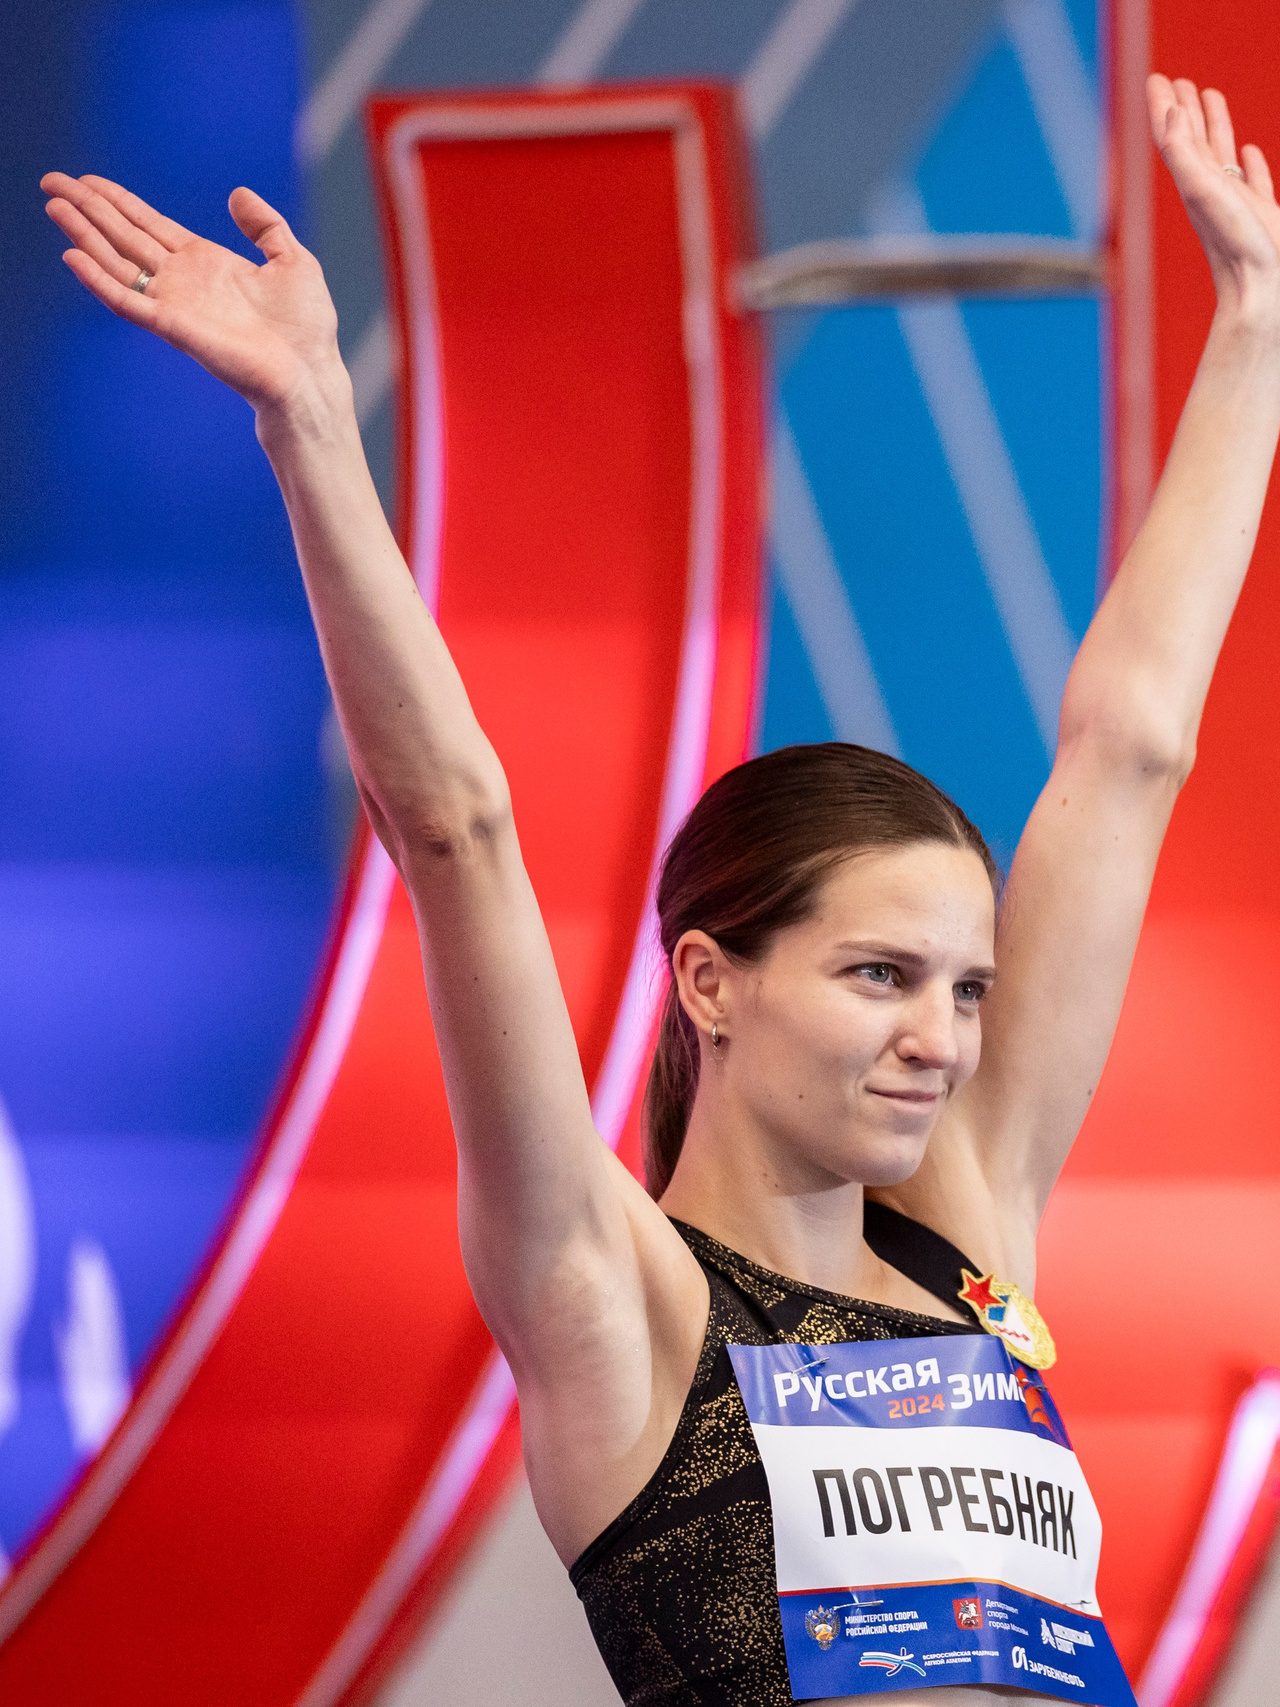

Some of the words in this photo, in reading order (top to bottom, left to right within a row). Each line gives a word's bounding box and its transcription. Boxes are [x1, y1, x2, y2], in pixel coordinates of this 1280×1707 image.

[773, 1358, 941, 1411] Русская
[887, 1394, 945, 1419] 2024
[813, 1467, 1077, 1560] ПОГРЕБНЯК
[845, 1613, 893, 1624] МИНИСТЕРСТВО
[894, 1611, 918, 1620] СПОРТА
[846, 1625, 887, 1636] РОССИЙСКОЙ
[888, 1622, 927, 1633] ФЕДЕРАЦИИ
